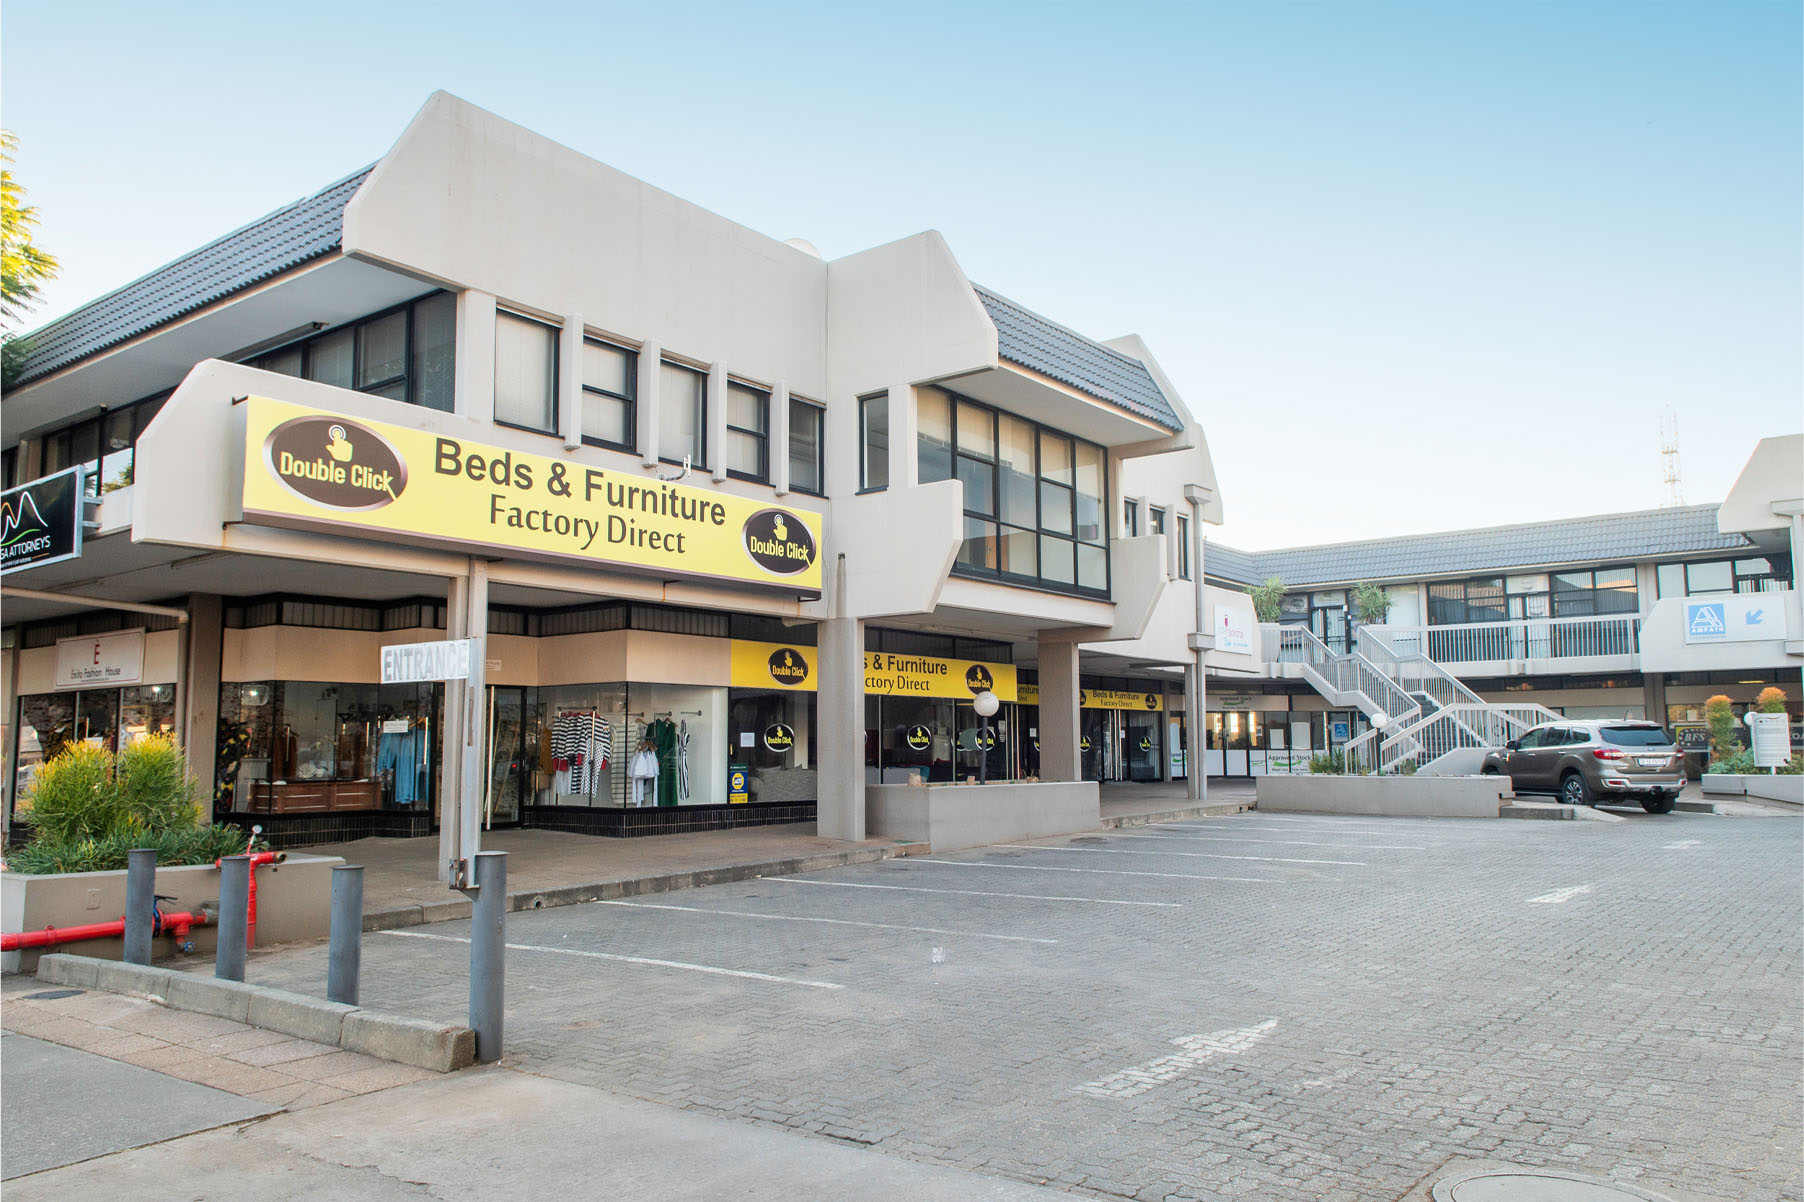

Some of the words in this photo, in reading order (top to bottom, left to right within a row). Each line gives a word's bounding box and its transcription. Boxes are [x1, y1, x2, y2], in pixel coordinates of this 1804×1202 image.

[280, 451, 346, 484] Double
[351, 464, 396, 494] Click
[435, 437, 534, 490] Beds
[547, 461, 572, 498] &
[585, 469, 726, 525] Furniture
[490, 493, 599, 551] Factory
[607, 514, 686, 554] Direct
[9, 535, 51, 557] ATTORNEYS
[750, 536, 784, 557] Double
[787, 542, 809, 562] Click
[84, 667, 102, 677] Fashion
[105, 666, 120, 676] House
[384, 643, 468, 682] ENTRANCE
[772, 665, 791, 675] Double
[792, 666, 804, 677] Click
[873, 654, 883, 670] &
[887, 655, 947, 675] Furniture
[864, 677, 894, 694] ctory
[897, 675, 930, 691] Direct
[1101, 699, 1118, 707] Factory
[1115, 692, 1139, 700] Furniture
[1684, 732, 1706, 742] BFS
